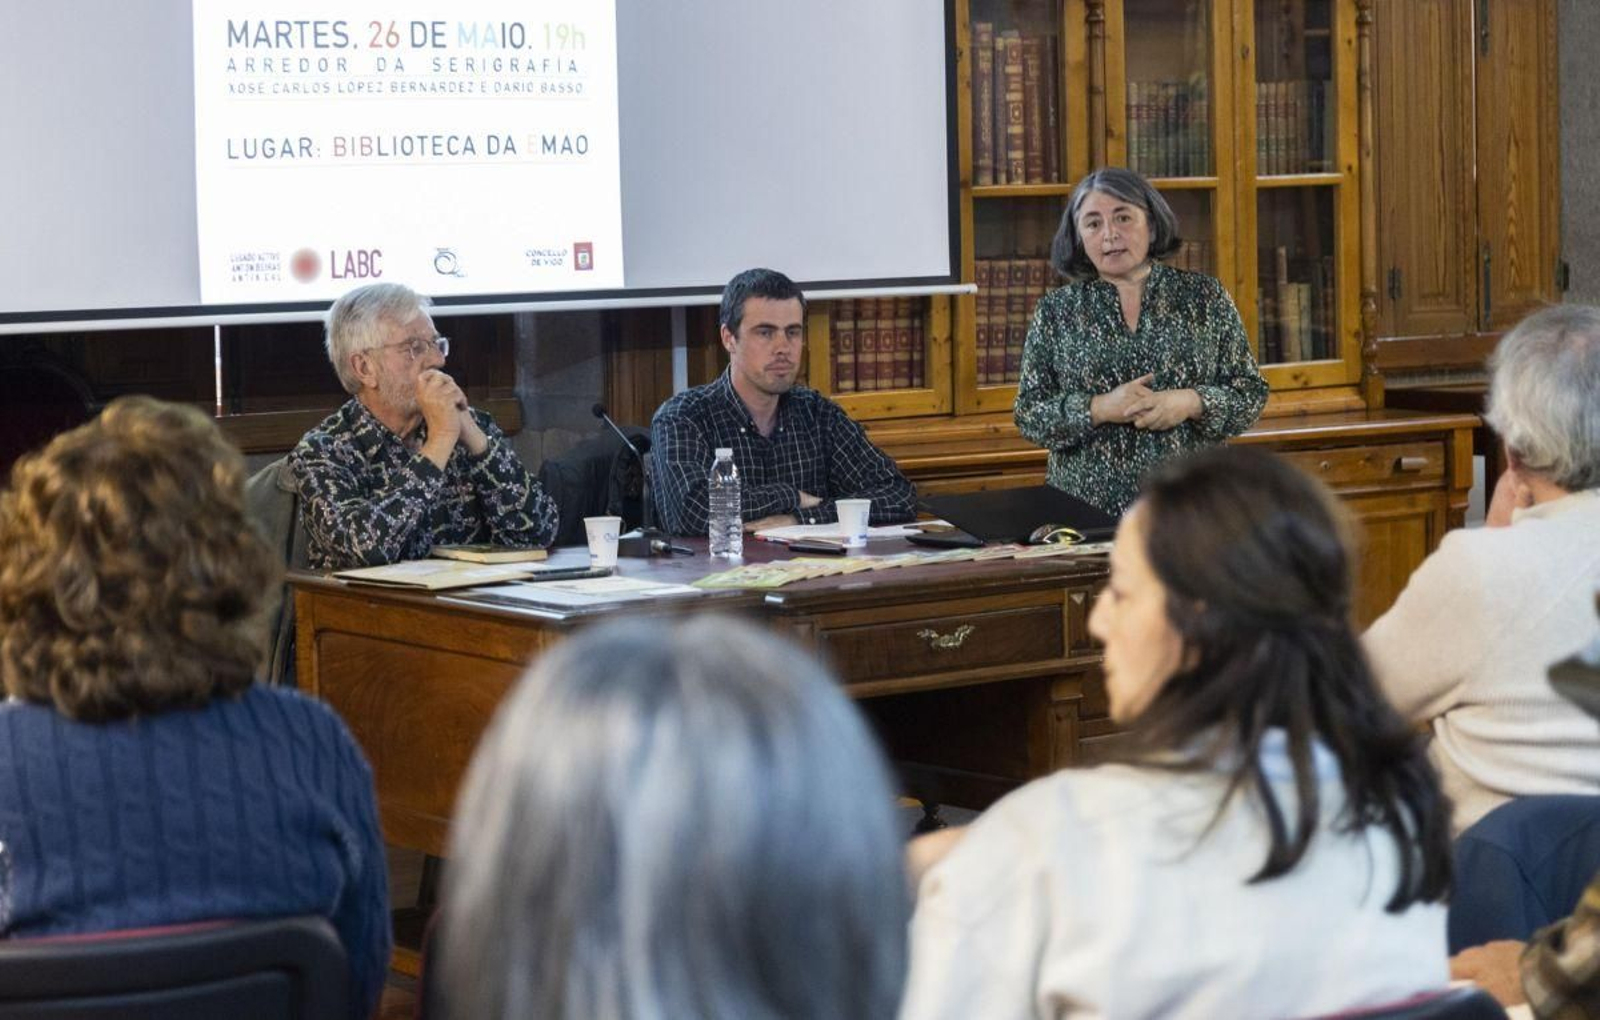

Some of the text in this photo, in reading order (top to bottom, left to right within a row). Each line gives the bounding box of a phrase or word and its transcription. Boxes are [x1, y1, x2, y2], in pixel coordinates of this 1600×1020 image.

[227, 19, 586, 50] MARTES. 26 DE MAIO. 19h
[227, 57, 347, 73] ARREDOR
[376, 57, 405, 72] DA
[272, 82, 331, 94] CARLOS
[227, 137, 321, 159] LUGAR:
[333, 135, 477, 158] BIBLIOTECA
[487, 134, 517, 155] DA
[330, 250, 383, 279] LABC
